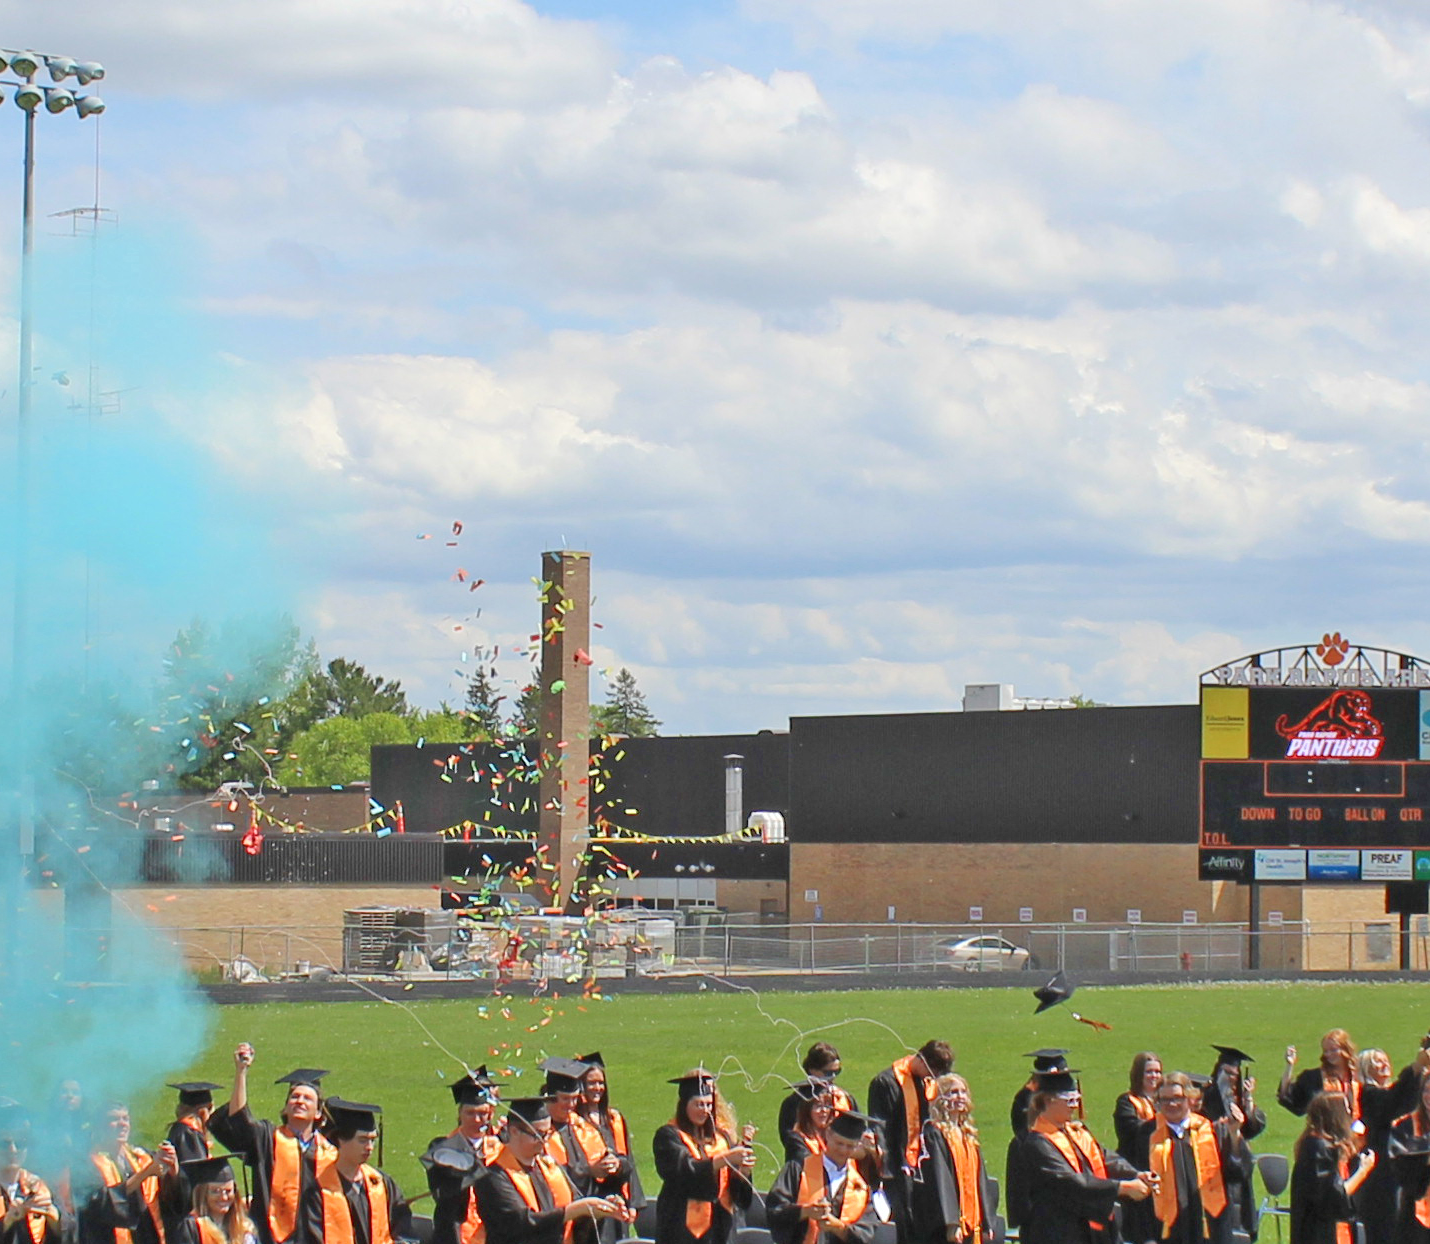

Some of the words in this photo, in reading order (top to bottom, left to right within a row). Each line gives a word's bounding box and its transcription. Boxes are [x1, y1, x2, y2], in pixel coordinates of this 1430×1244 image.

[1218, 667, 1282, 686] PARK
[1288, 668, 1375, 687] RAPIDS
[1286, 738, 1381, 757] PANTHERS
[1240, 807, 1276, 821] DOWN
[1288, 807, 1303, 821] TO
[1305, 807, 1322, 821] GO
[1344, 807, 1370, 822] BALL
[1371, 807, 1387, 822] ON
[1399, 807, 1423, 822] QTR
[1203, 855, 1245, 870] Affinity
[1370, 853, 1404, 864] PREAF
